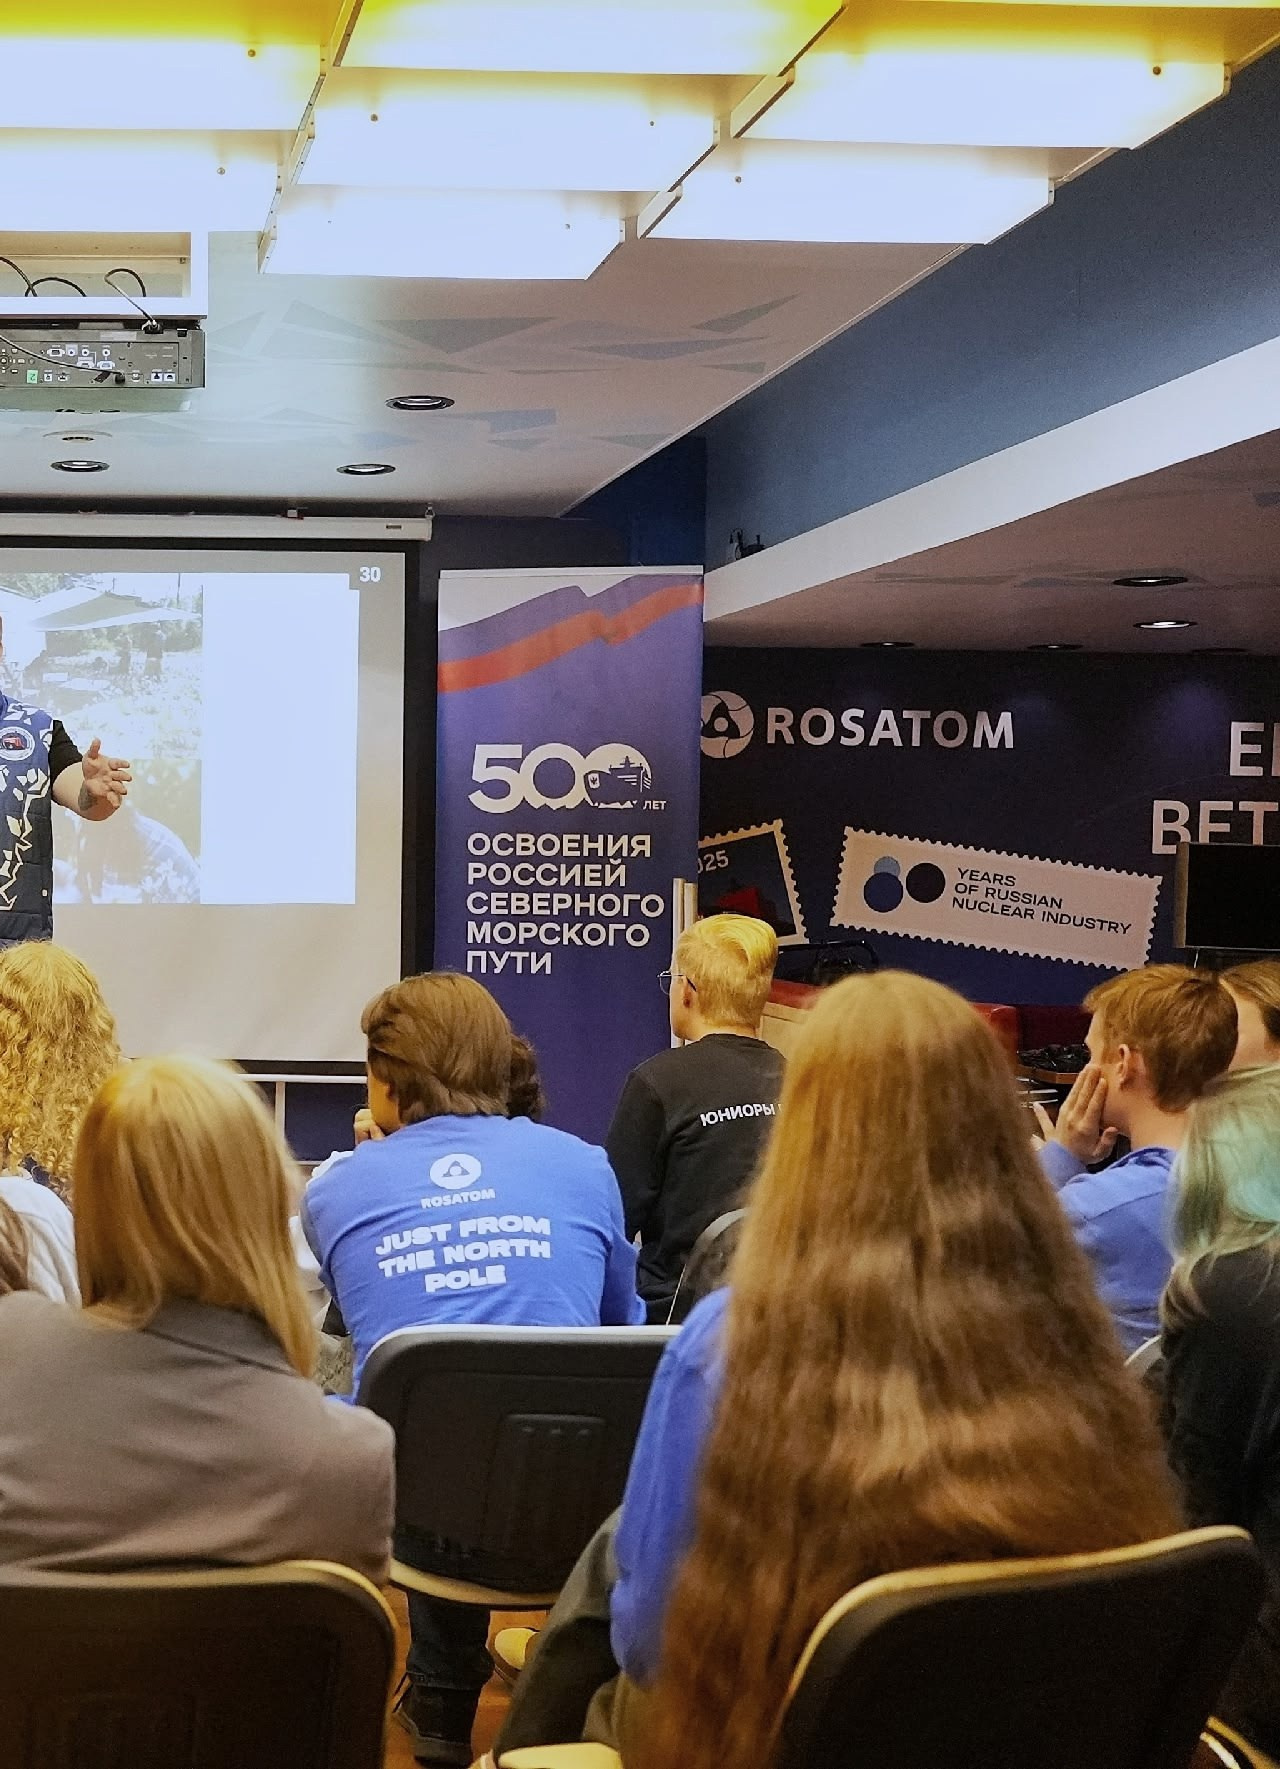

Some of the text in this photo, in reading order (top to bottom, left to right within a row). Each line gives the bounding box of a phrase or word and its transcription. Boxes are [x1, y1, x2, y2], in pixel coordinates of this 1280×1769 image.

[359, 566, 381, 583] 30
[767, 707, 1014, 749] ROSATOM
[1229, 721, 1280, 777] E
[468, 742, 666, 814] 500 ЛЕТ
[467, 832, 651, 857] ОСВОЕНИЯ
[468, 858, 626, 887] РОССИЕЙ
[957, 867, 1017, 887] YEARS
[466, 891, 665, 918] СЕВЕРНОГО
[954, 882, 1063, 909] OF RUSSIAN
[952, 897, 1132, 935] NUCLEAR INDUSTRY
[467, 921, 650, 947] МОРСКОГО
[466, 950, 552, 974] ПУТИ
[700, 1103, 776, 1126] ЮНИОРЫ
[421, 1188, 496, 1209] ROSATOM
[375, 1214, 551, 1255] JUST FROM
[378, 1238, 551, 1278] THE NORTH
[424, 1264, 507, 1293] POLE
